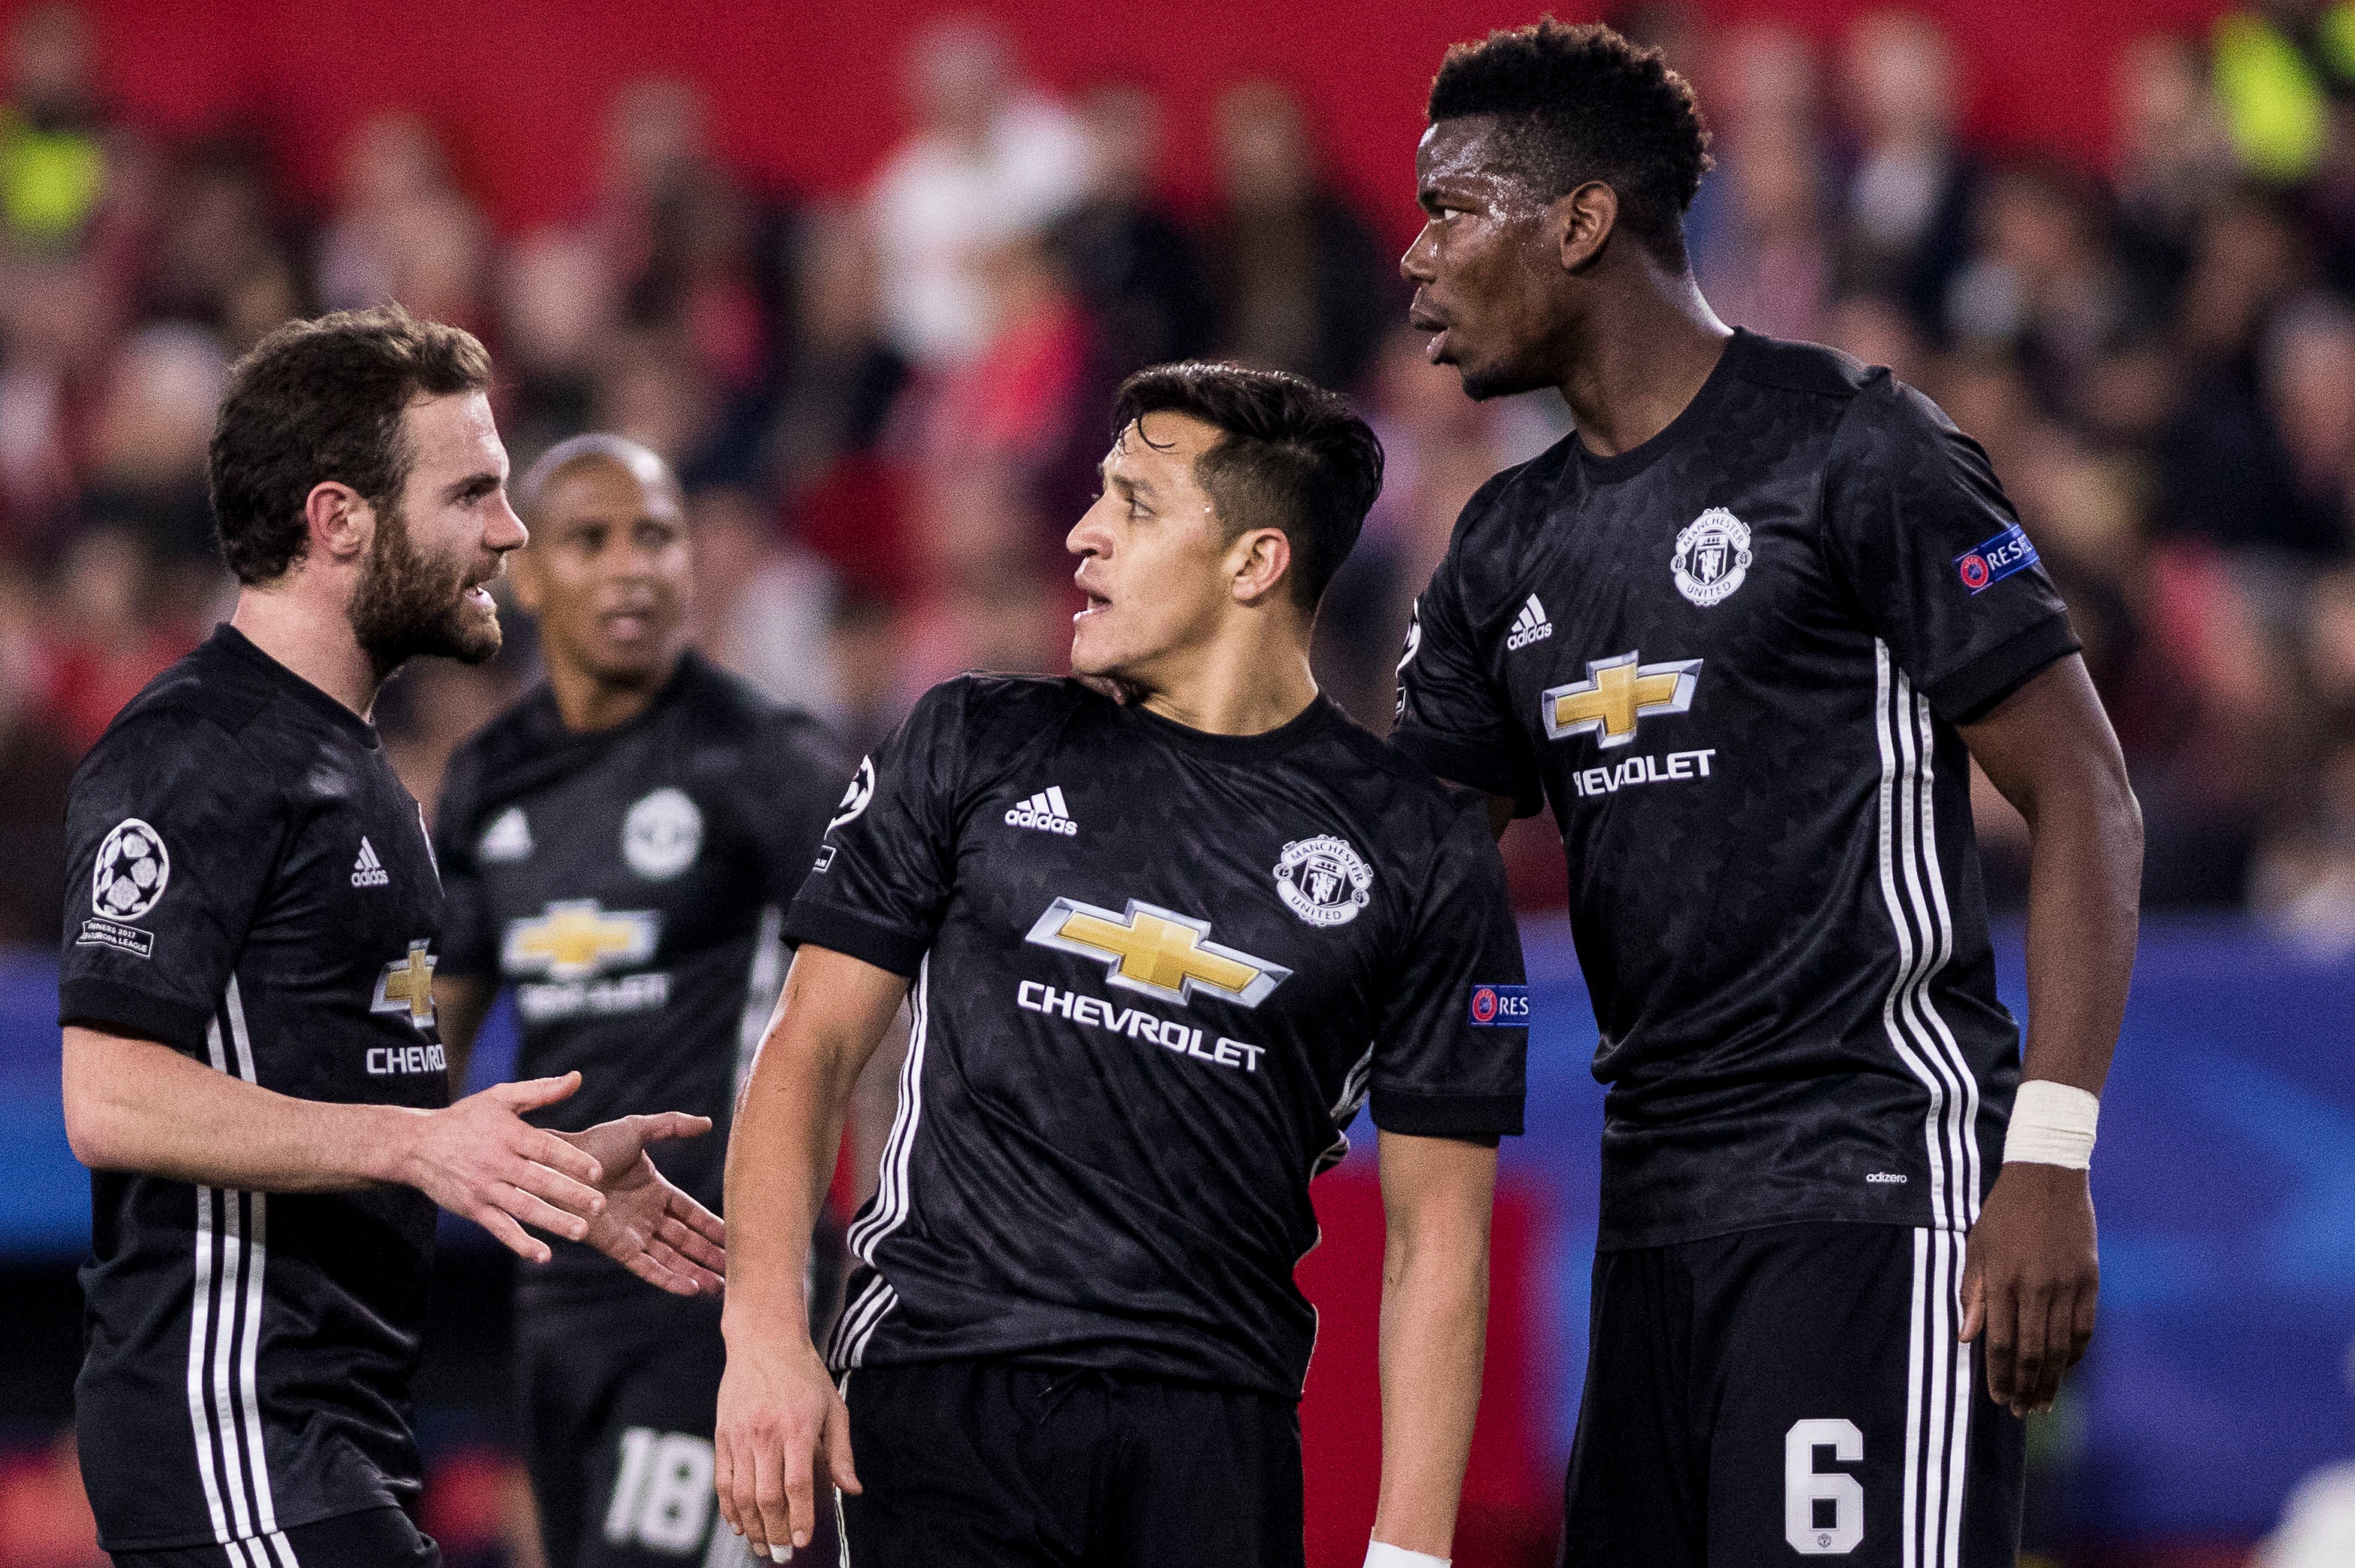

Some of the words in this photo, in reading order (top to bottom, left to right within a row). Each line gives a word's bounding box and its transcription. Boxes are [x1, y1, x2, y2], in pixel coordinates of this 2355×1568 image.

[1684, 516, 1744, 546] MANCHESTER
[1687, 581, 1731, 598] UNITED
[1507, 622, 1552, 651] adidas
[1004, 809, 1077, 837] adidas
[1290, 842, 1363, 881] MANCHESTER
[351, 868, 389, 887] adidas
[1291, 895, 1342, 919] UNITED
[117, 928, 136, 938] 2017
[1017, 980, 1266, 1071] CHEVROLET
[366, 1044, 446, 1074] CHEVRO
[1866, 1171, 1907, 1184] adizero
[605, 1426, 715, 1551] 18
[1785, 1419, 1864, 1554] 6
